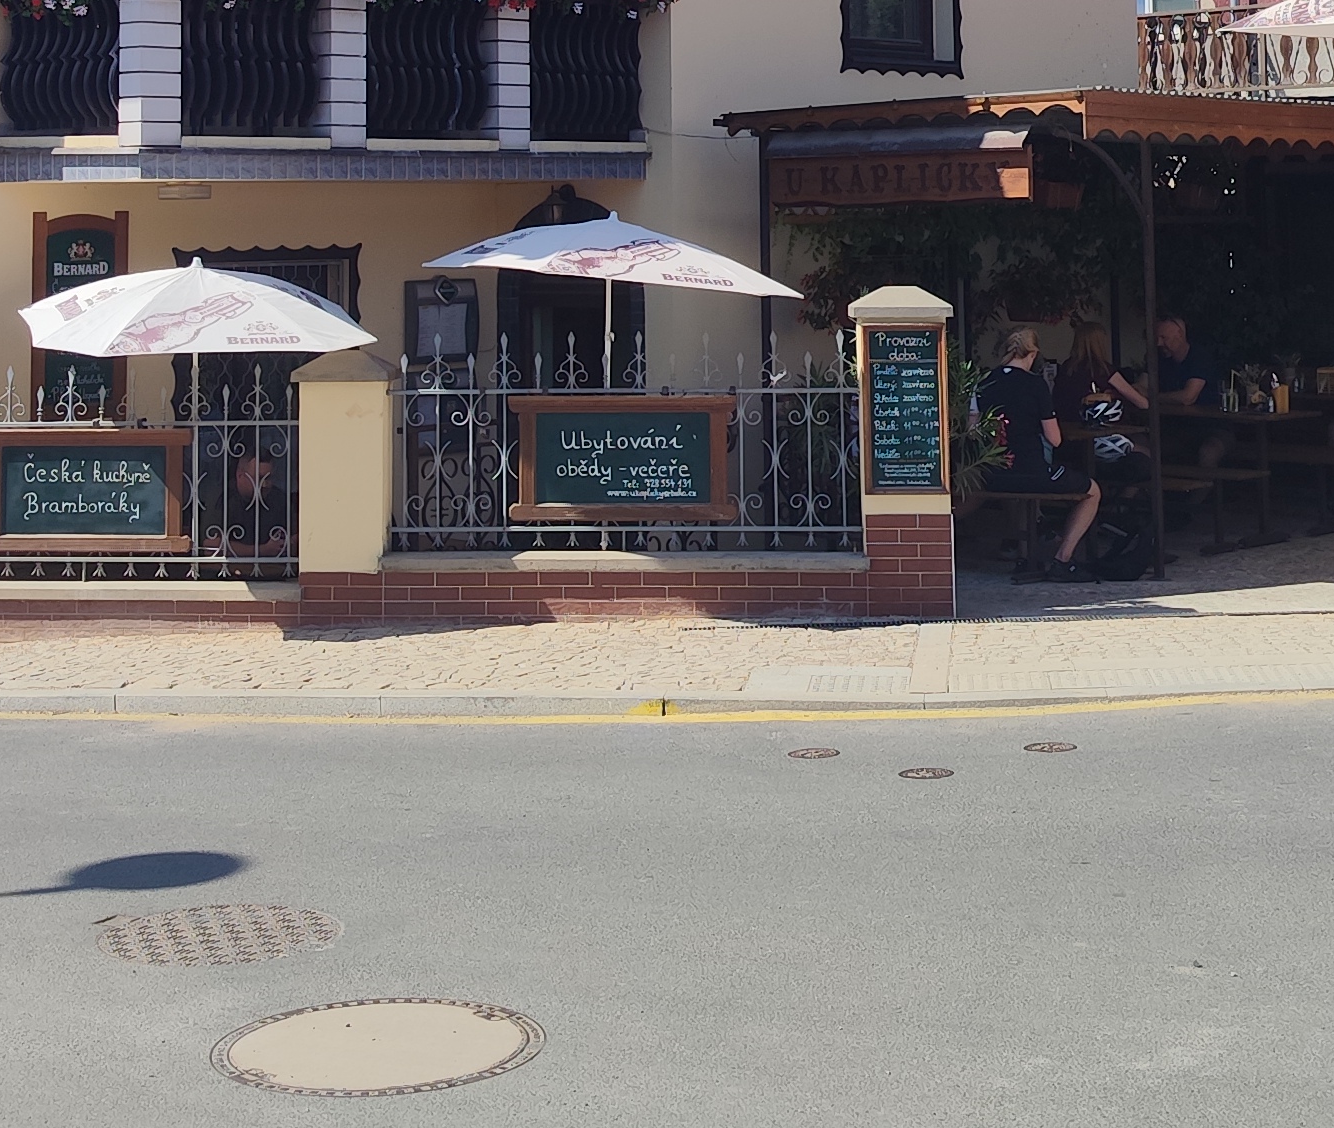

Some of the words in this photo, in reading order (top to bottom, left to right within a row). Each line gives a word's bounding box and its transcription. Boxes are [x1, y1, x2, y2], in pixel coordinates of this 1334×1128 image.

[785, 168, 806, 196] U
[53, 260, 109, 276] BERNARD
[662, 272, 735, 287] BERNARD
[225, 334, 301, 346] BERNARD
[874, 332, 932, 347] Provozní
[888, 348, 922, 361] doba:
[560, 424, 684, 459] Ubytování
[24, 452, 86, 483] Česká
[93, 460, 151, 489] kuchyně
[556, 458, 612, 485] obědy
[22, 491, 141, 524] Bramboráky
